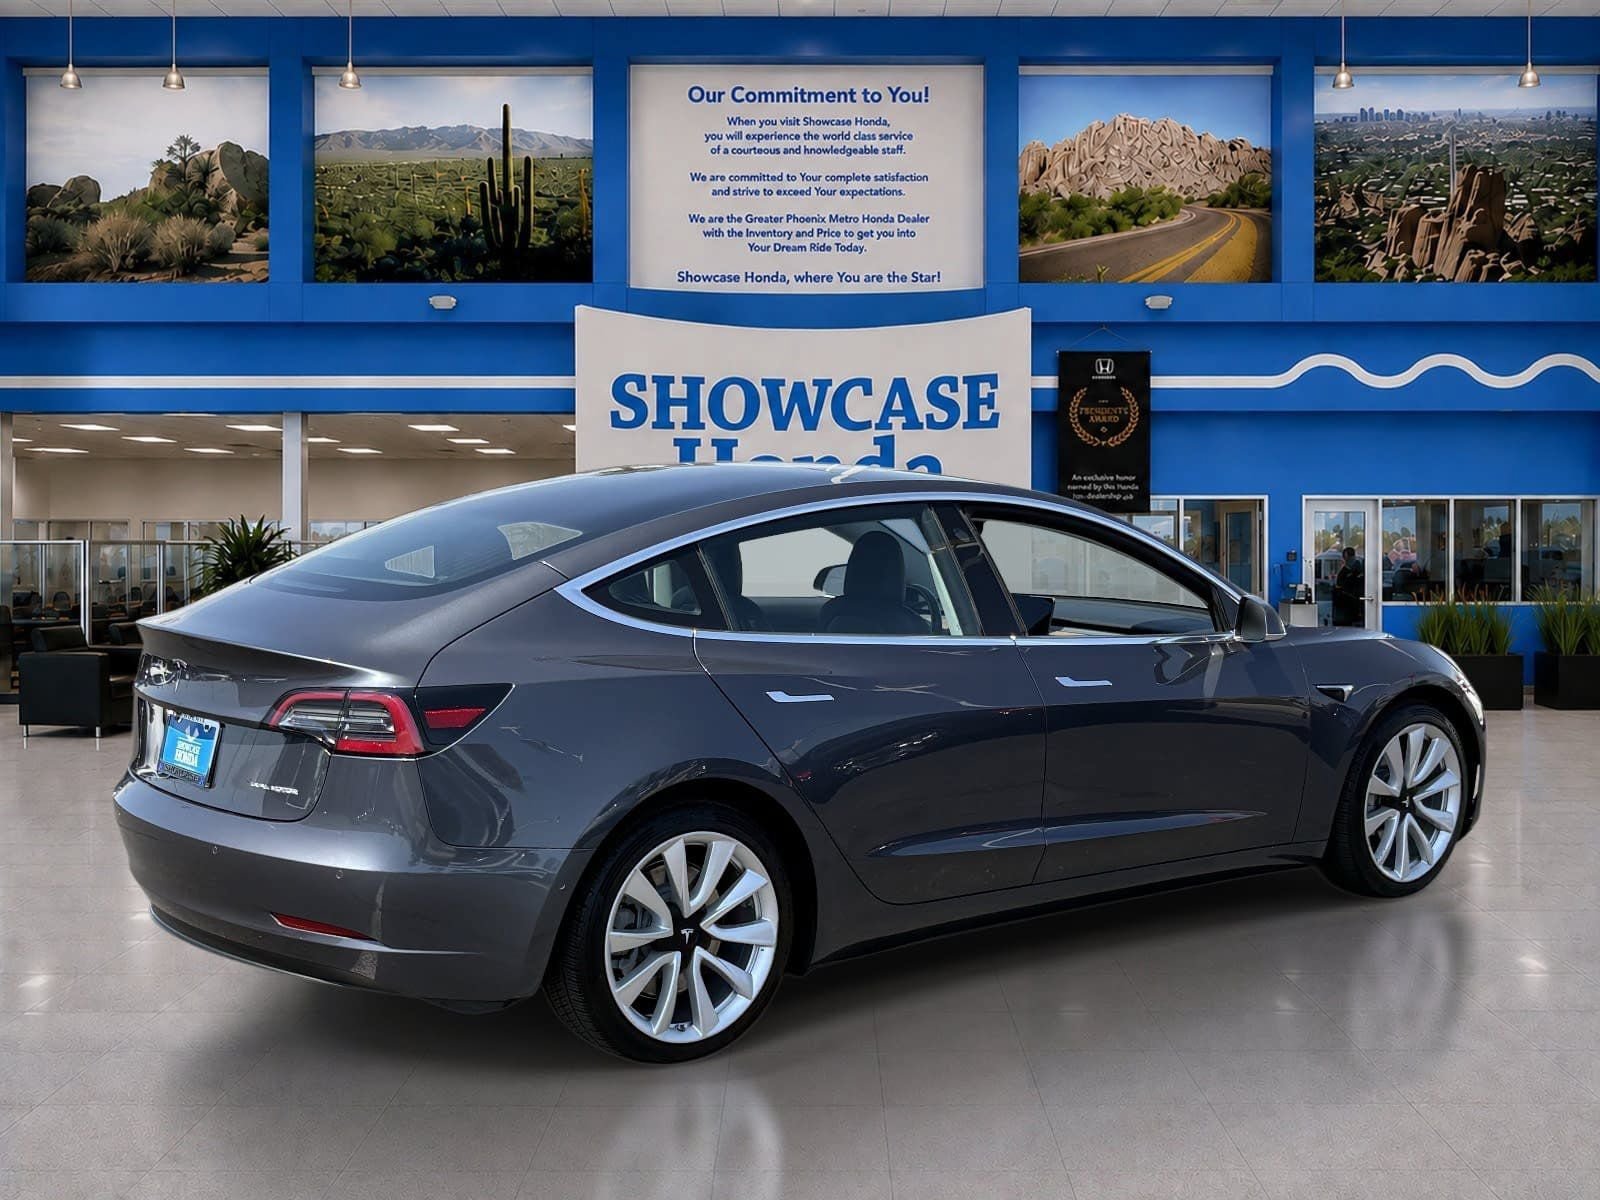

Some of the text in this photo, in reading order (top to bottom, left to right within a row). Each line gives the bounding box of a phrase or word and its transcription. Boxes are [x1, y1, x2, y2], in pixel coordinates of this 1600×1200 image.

[687, 85, 930, 104] Our Commitment to You!
[726, 116, 891, 129] When you visit Showcase Honda,
[704, 130, 914, 144] you will experience the world class service
[710, 144, 721, 155] of
[722, 147, 730, 155] a
[730, 146, 781, 155] courteous
[782, 144, 802, 155] and
[881, 144, 906, 155] staff.
[689, 171, 929, 185] We are committed to Your complete satisfaction
[711, 185, 906, 200] and strive to exceed Your expectations.
[688, 213, 931, 224] We are the Greater Phoenix Metro Honda Dealer
[702, 227, 917, 241] with the Inventory and Price to get you into
[747, 242, 868, 255] Your Dream Ride Today.
[677, 270, 941, 285] Showcase Honda, where You are the Star!
[610, 373, 1000, 431] SHOWCASE
